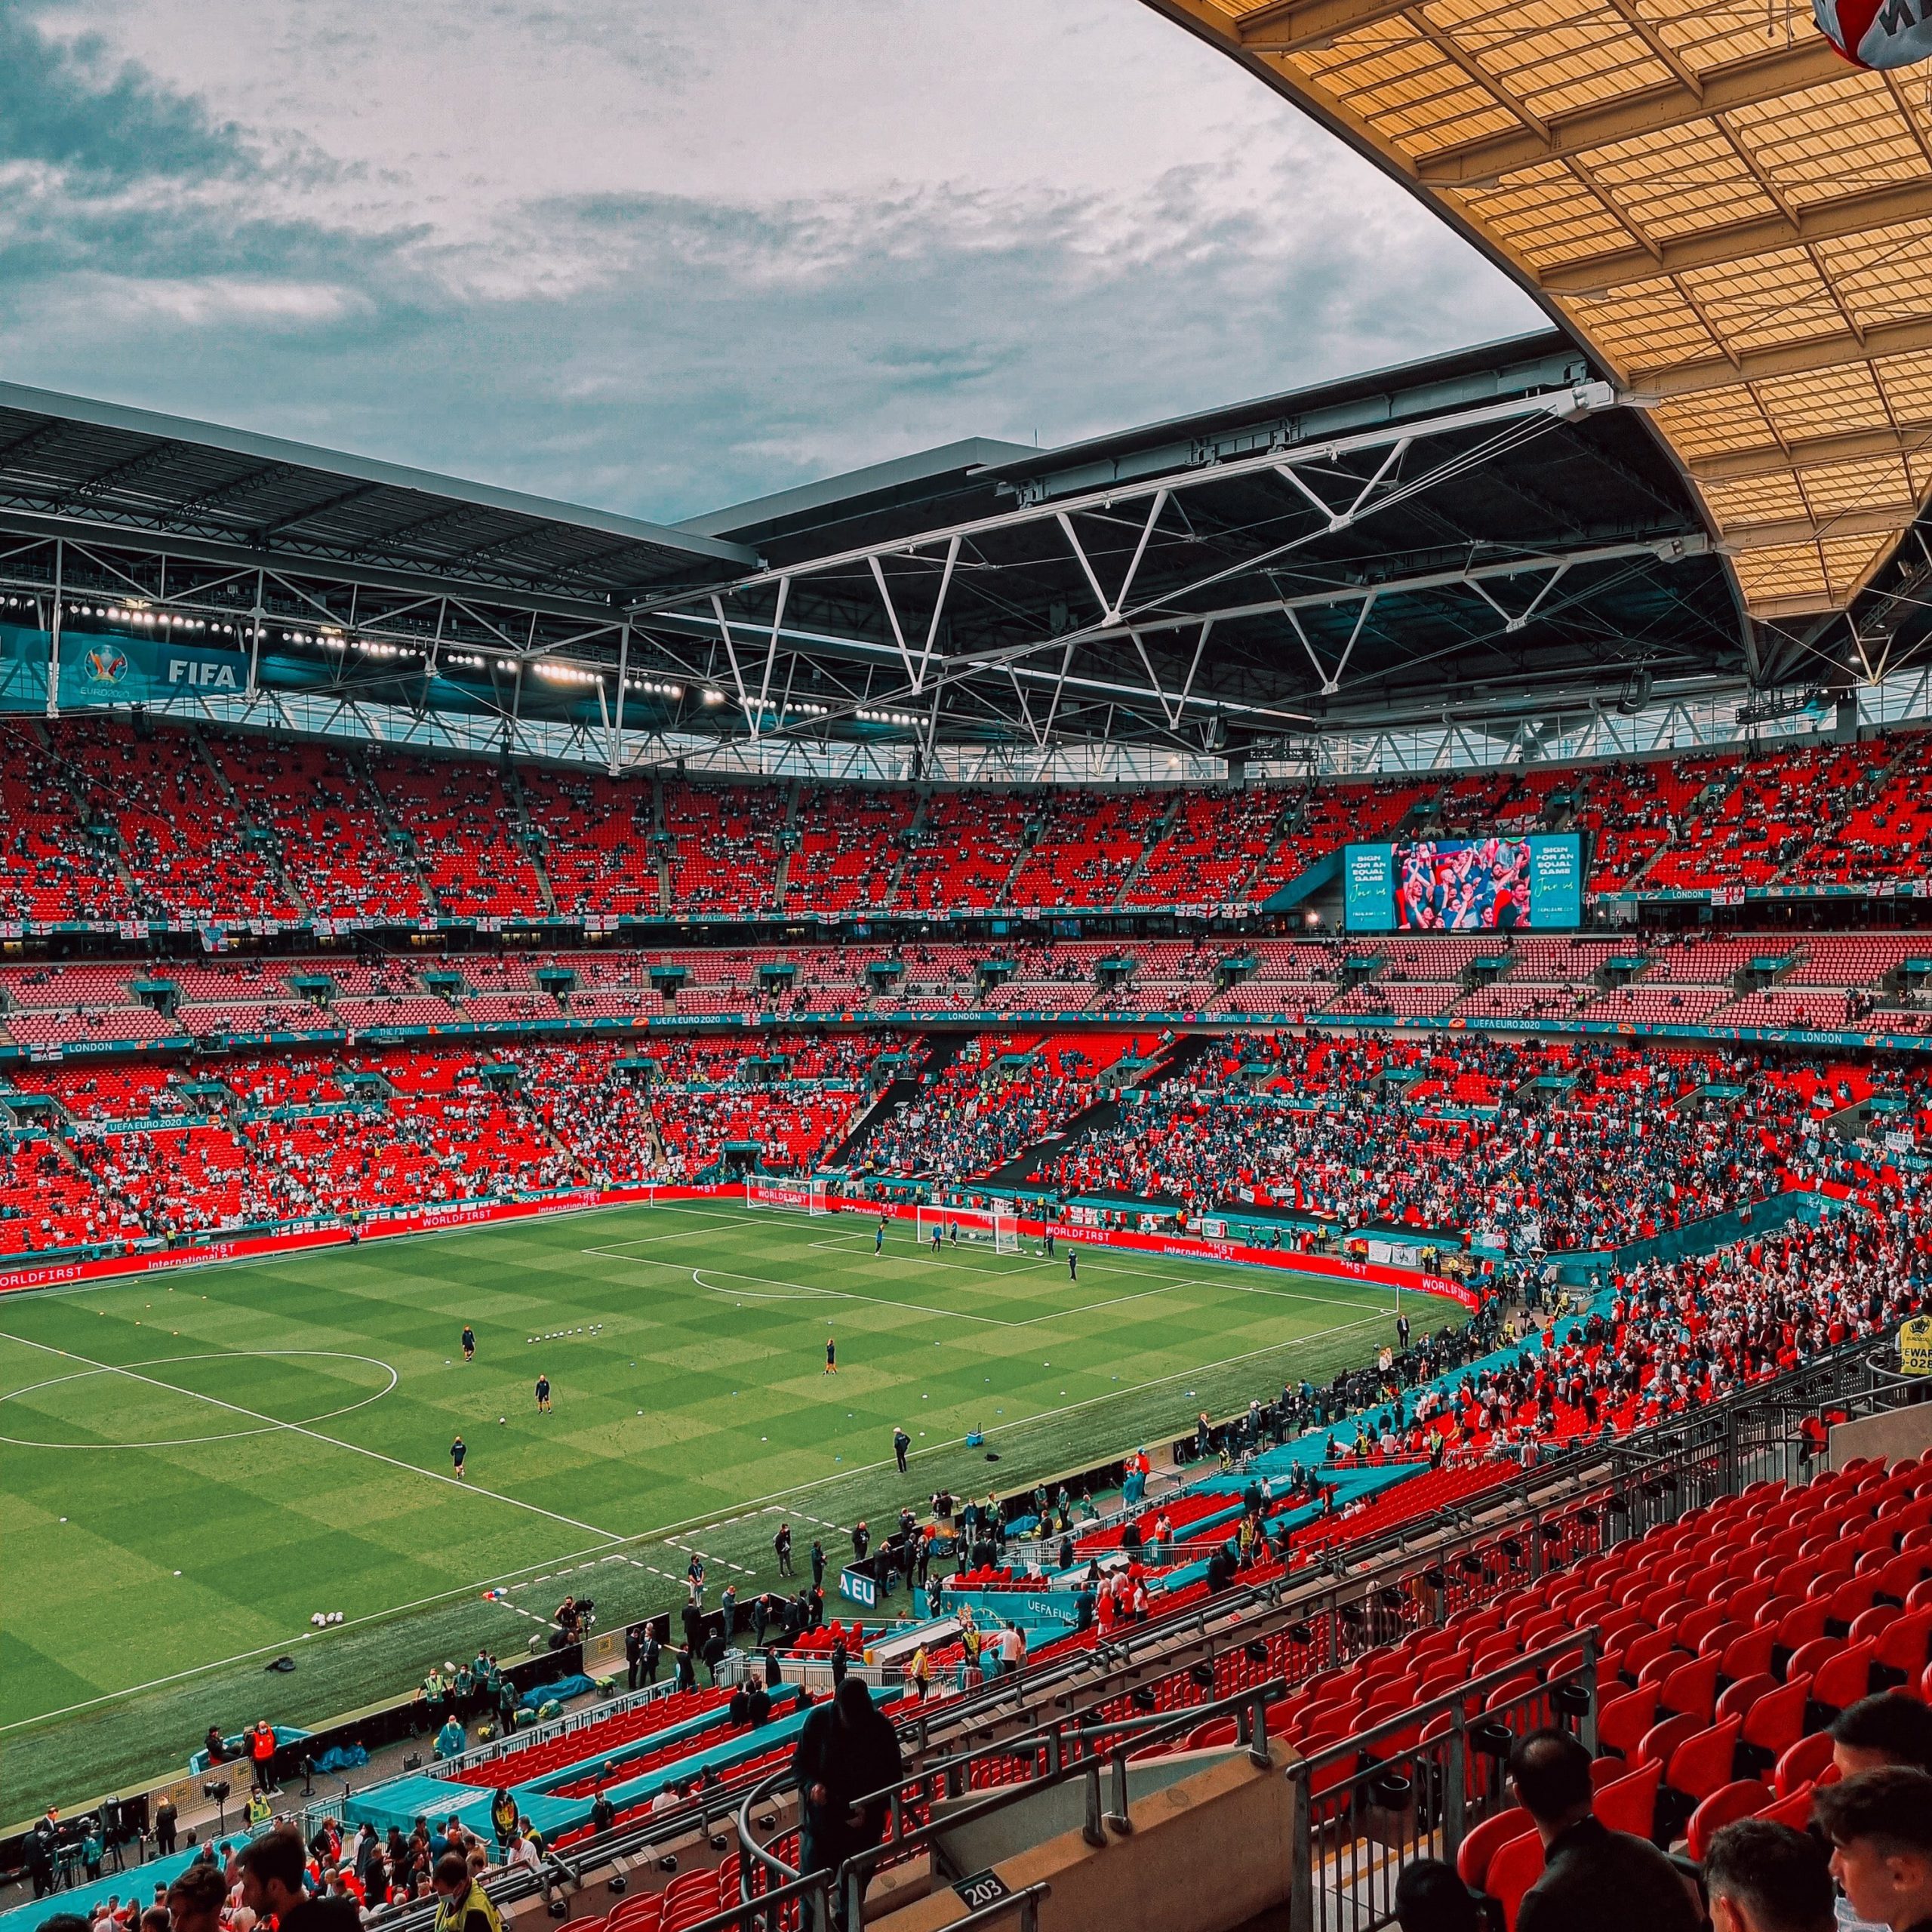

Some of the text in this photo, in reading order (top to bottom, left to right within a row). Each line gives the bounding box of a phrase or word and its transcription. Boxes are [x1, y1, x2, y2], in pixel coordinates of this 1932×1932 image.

[169, 660, 237, 688] FIFA
[1672, 890, 1703, 898] LONDON
[656, 1015, 720, 1024] UEFA EURO 2020
[1473, 1020, 1540, 1029] UEFA EURO 2020
[1801, 1032, 1841, 1043] LONDON
[69, 1042, 112, 1053] LONDON
[110, 1118, 182, 1131] UEFA EURO 2020
[423, 1210, 491, 1227] WORLDFIRST
[1046, 1225, 1110, 1241] WORLDFIRST
[1422, 1278, 1471, 1304] WORLDFIRST
[1028, 1599, 1052, 1617] UEFA
[964, 1879, 1002, 1906] 203
